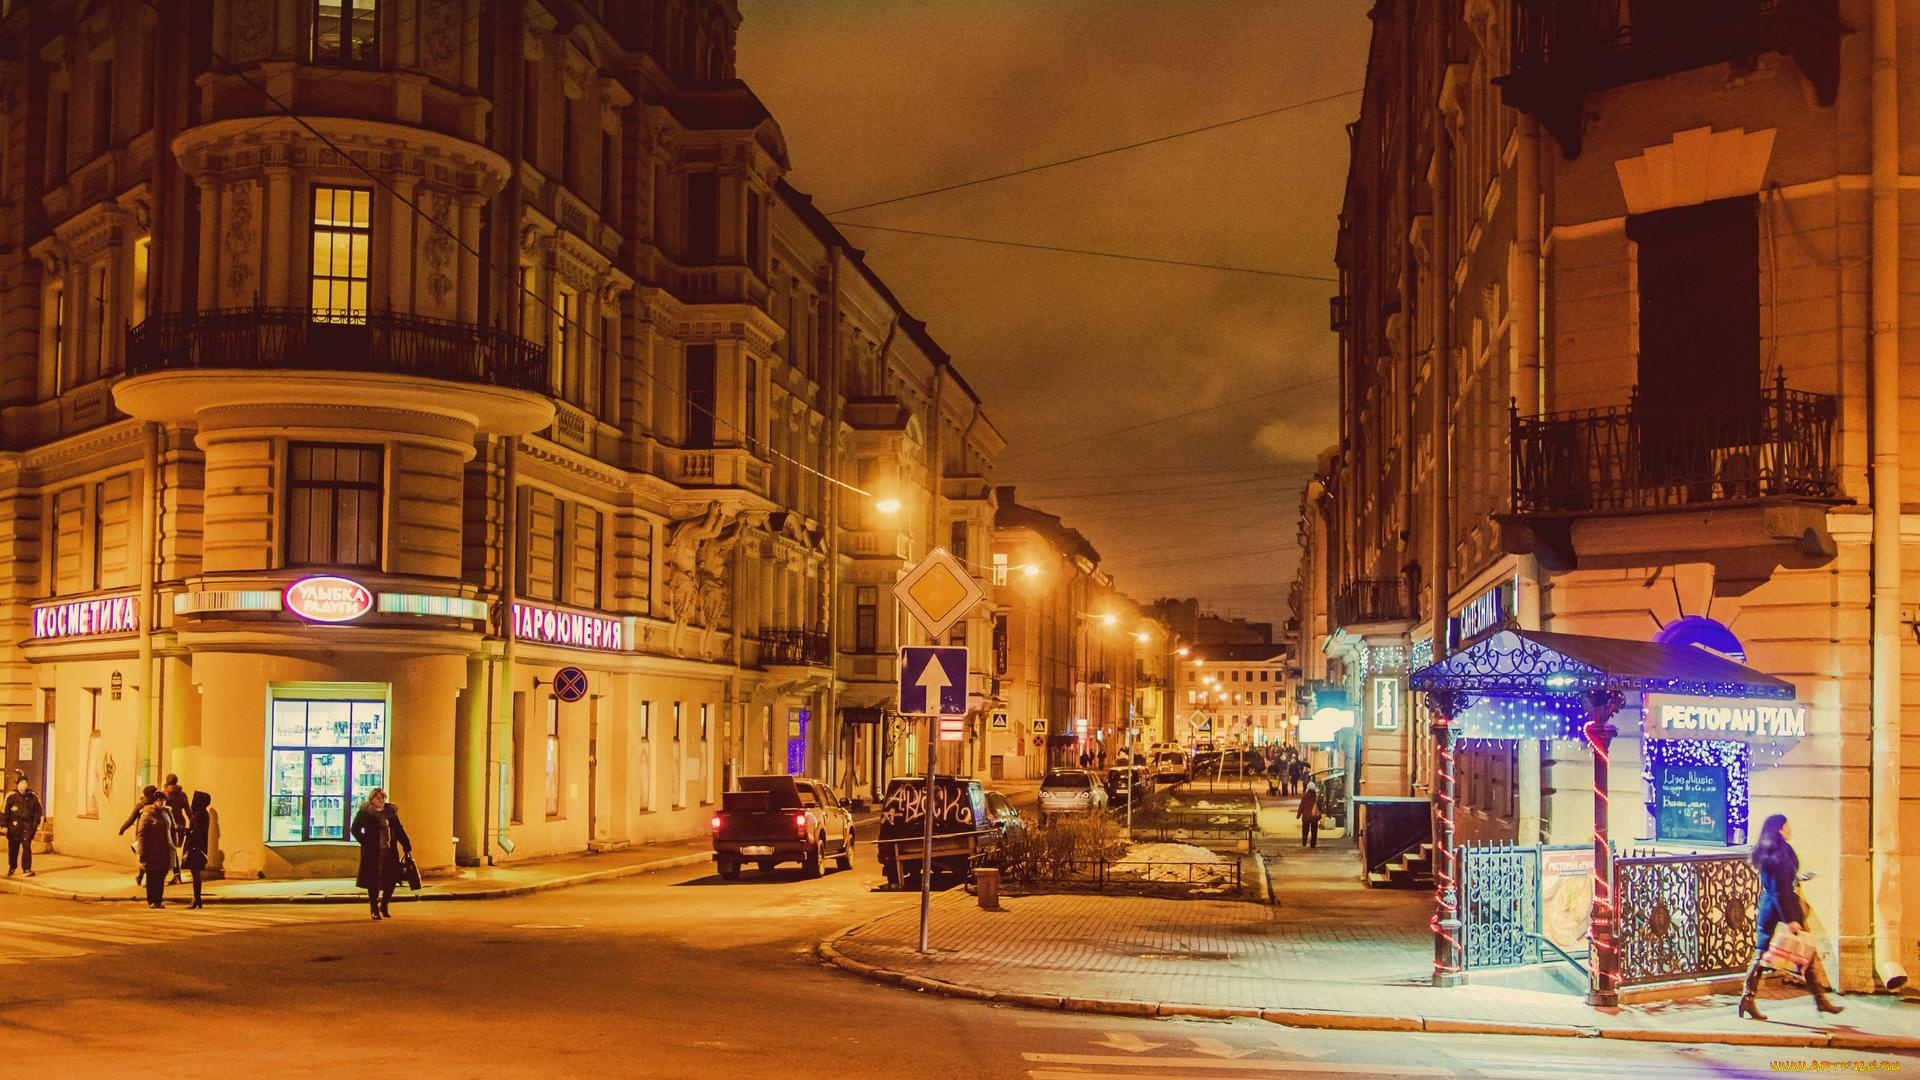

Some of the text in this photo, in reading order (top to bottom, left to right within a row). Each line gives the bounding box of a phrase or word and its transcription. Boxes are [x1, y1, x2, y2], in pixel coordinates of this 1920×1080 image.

[299, 586, 365, 603] УЛЫБКА
[303, 599, 358, 613] РАДУГИ
[35, 597, 134, 638] КОСМЕТИКА
[1661, 705, 1806, 737] РЕСТОРАН РИМ
